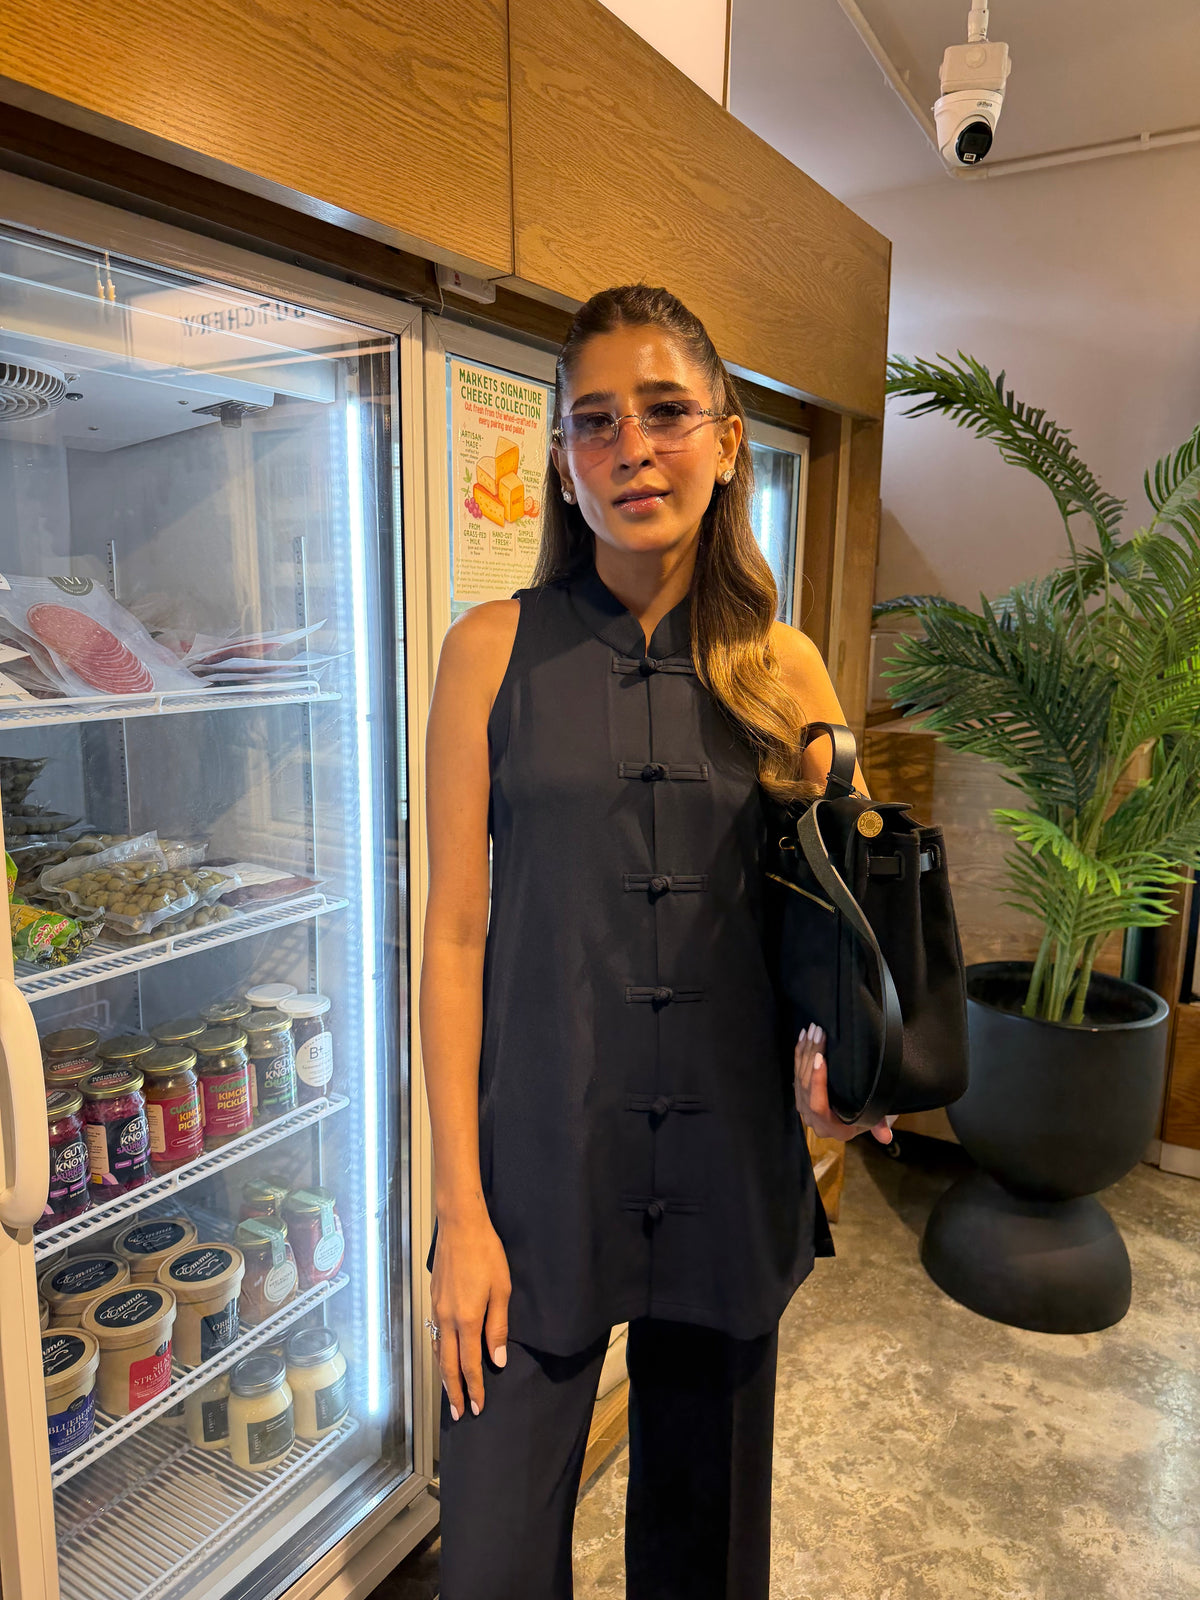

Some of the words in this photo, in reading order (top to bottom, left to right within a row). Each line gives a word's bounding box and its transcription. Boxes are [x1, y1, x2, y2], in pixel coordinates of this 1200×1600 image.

[459, 367, 498, 393] MARKETS
[500, 381, 542, 405] SIGNATURE
[461, 385, 493, 407] CHEESE
[495, 395, 541, 420] COLLECTION
[63, 1144, 82, 1159] GUY
[175, 1251, 214, 1277] Emma
[100, 1292, 144, 1320] Emma
